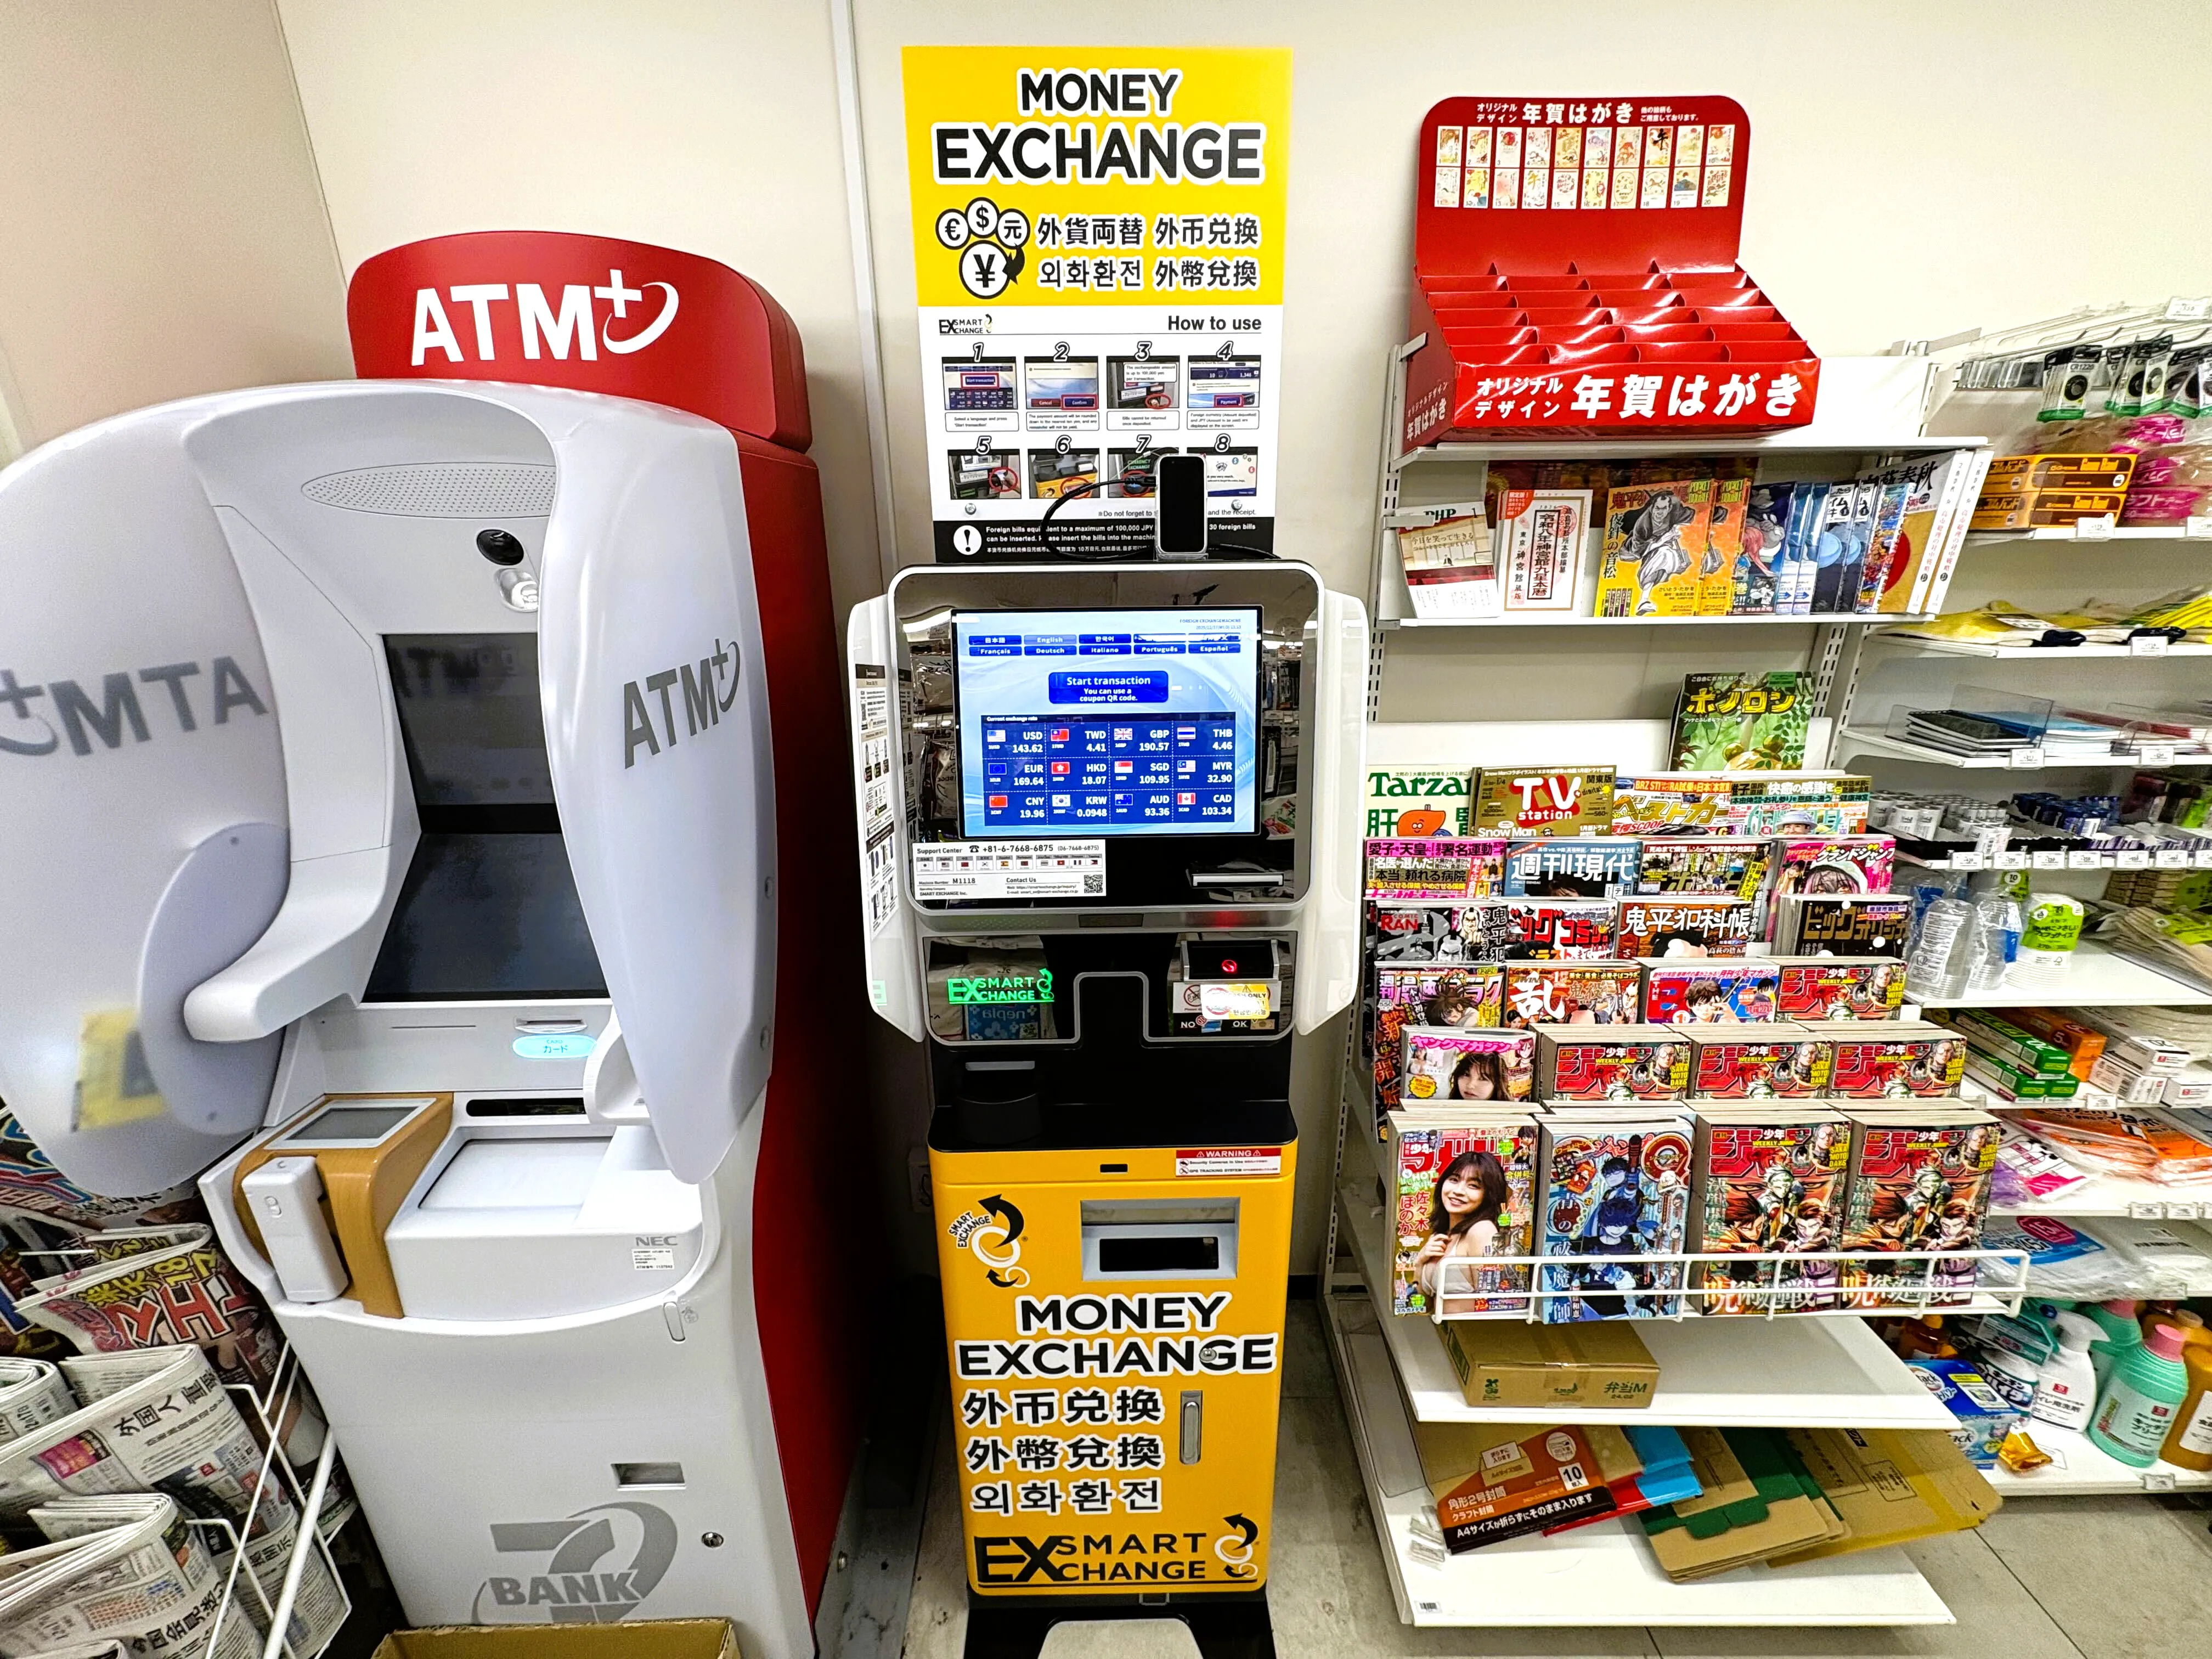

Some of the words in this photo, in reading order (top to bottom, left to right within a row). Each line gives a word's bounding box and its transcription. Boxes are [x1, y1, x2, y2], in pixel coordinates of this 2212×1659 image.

[1022, 74, 1178, 111] MONEY
[1476, 114, 1517, 123] デザイン
[1477, 104, 1517, 112] オリジナル
[1522, 103, 1633, 124] 年賀はがき
[937, 128, 1261, 179] EXCHANGE
[1038, 218, 1142, 245] 外貨両替
[1155, 218, 1259, 244] 外币兑换
[1040, 260, 1142, 287] 외화환전
[1155, 261, 1257, 286] 外幣兌換
[1169, 315, 1204, 330] How
[1210, 317, 1226, 330] to
[1233, 319, 1261, 330] use
[973, 342, 984, 363] 1
[1054, 342, 1070, 362] 2
[1135, 341, 1152, 361] 3
[1216, 341, 1233, 360] 4
[1477, 377, 1561, 396] オリジナル
[1572, 373, 1802, 419] 年賀はがき
[1475, 400, 1561, 418] デザイン
[1407, 398, 1447, 441] 年賀はがき
[976, 436, 991, 454] 5
[1056, 436, 1071, 453] 6
[1136, 435, 1151, 453] 7
[1215, 433, 1231, 453] 8
[1412, 533, 1474, 543] 今日を笑って生きる
[980, 647, 1011, 656] Français
[1200, 646, 1228, 654] Español
[1067, 676, 1091, 685] Start
[1094, 676, 1150, 685] transaction
[1686, 687, 1796, 714] ボノロン
[1024, 731, 1042, 740] USD
[1085, 730, 1106, 739] TWD
[1150, 729, 1169, 738] GBP
[1213, 729, 1232, 737] THB
[1013, 743, 1042, 753] 143.62
[1086, 743, 1106, 752] 4.41
[1139, 742, 1169, 751] 190.57
[1213, 741, 1232, 750] 4.46
[1025, 764, 1043, 773] EUR
[1086, 763, 1106, 772] HKD
[1150, 762, 1169, 771] SGD
[1213, 761, 1232, 770] MYR
[1014, 777, 1043, 786] 169.64
[1082, 776, 1107, 785] 18.07
[1139, 775, 1169, 784] 109.95
[1207, 774, 1232, 783] 32.90
[1368, 772, 1470, 797] Tarza
[1587, 775, 1612, 783] 関東版
[1086, 796, 1107, 805] KRW
[1150, 795, 1169, 804] AUD
[1214, 794, 1232, 804] CAD
[1514, 776, 1582, 810] TV
[1025, 797, 1044, 806] CNY
[1020, 810, 1044, 819] 19.96
[1077, 809, 1107, 818] 0.0948
[1145, 808, 1169, 817] 93.36
[1203, 807, 1232, 816] 103.34
[1519, 811, 1572, 820] station
[1478, 828, 1510, 837] Snow
[1513, 828, 1536, 837] Man
[1511, 854, 1634, 882] 週刊現代
[1381, 916, 1418, 931] RAN
[1620, 909, 1752, 938] 鬼平犯科帳
[1829, 969, 1848, 978] 少年
[978, 977, 1034, 989] SMART
[1380, 975, 1395, 998] 週刊
[979, 989, 1035, 1000] CHANGE
[1510, 971, 1565, 1019] 乱
[543, 1045, 568, 1053] カード
[1412, 1036, 1514, 1052] ヤングマガジン
[1606, 1047, 1627, 1057] 少年
[1764, 1129, 1785, 1139] 少年
[1398, 1196, 1414, 1235] ほのか
[1415, 1191, 1431, 1231] 佐々木
[949, 1212, 973, 1235] SMART
[958, 1216, 991, 1247] EXCHANGE
[636, 1235, 678, 1246] NEC
[1022, 1296, 1227, 1331] MONEY
[959, 1337, 1274, 1376] EXCHANGE
[1604, 1381, 1648, 1393] 弁当M
[963, 1389, 1161, 1425] 外币兑换
[114, 1394, 182, 1437] 外国人
[967, 1437, 1161, 1471] 外幣兌換
[1563, 1466, 1582, 1482] 10
[973, 1481, 1159, 1514] 외화환전
[1448, 1485, 1507, 1511] 角形2号封筒
[1452, 1505, 1494, 1522] クラフト封筒
[1457, 1493, 1593, 1538] A4サイズが折らずにそのまま入ります
[1057, 1533, 1206, 1555] SMART
[1061, 1561, 1205, 1581] CHANGE
[488, 1572, 640, 1605] BANK
